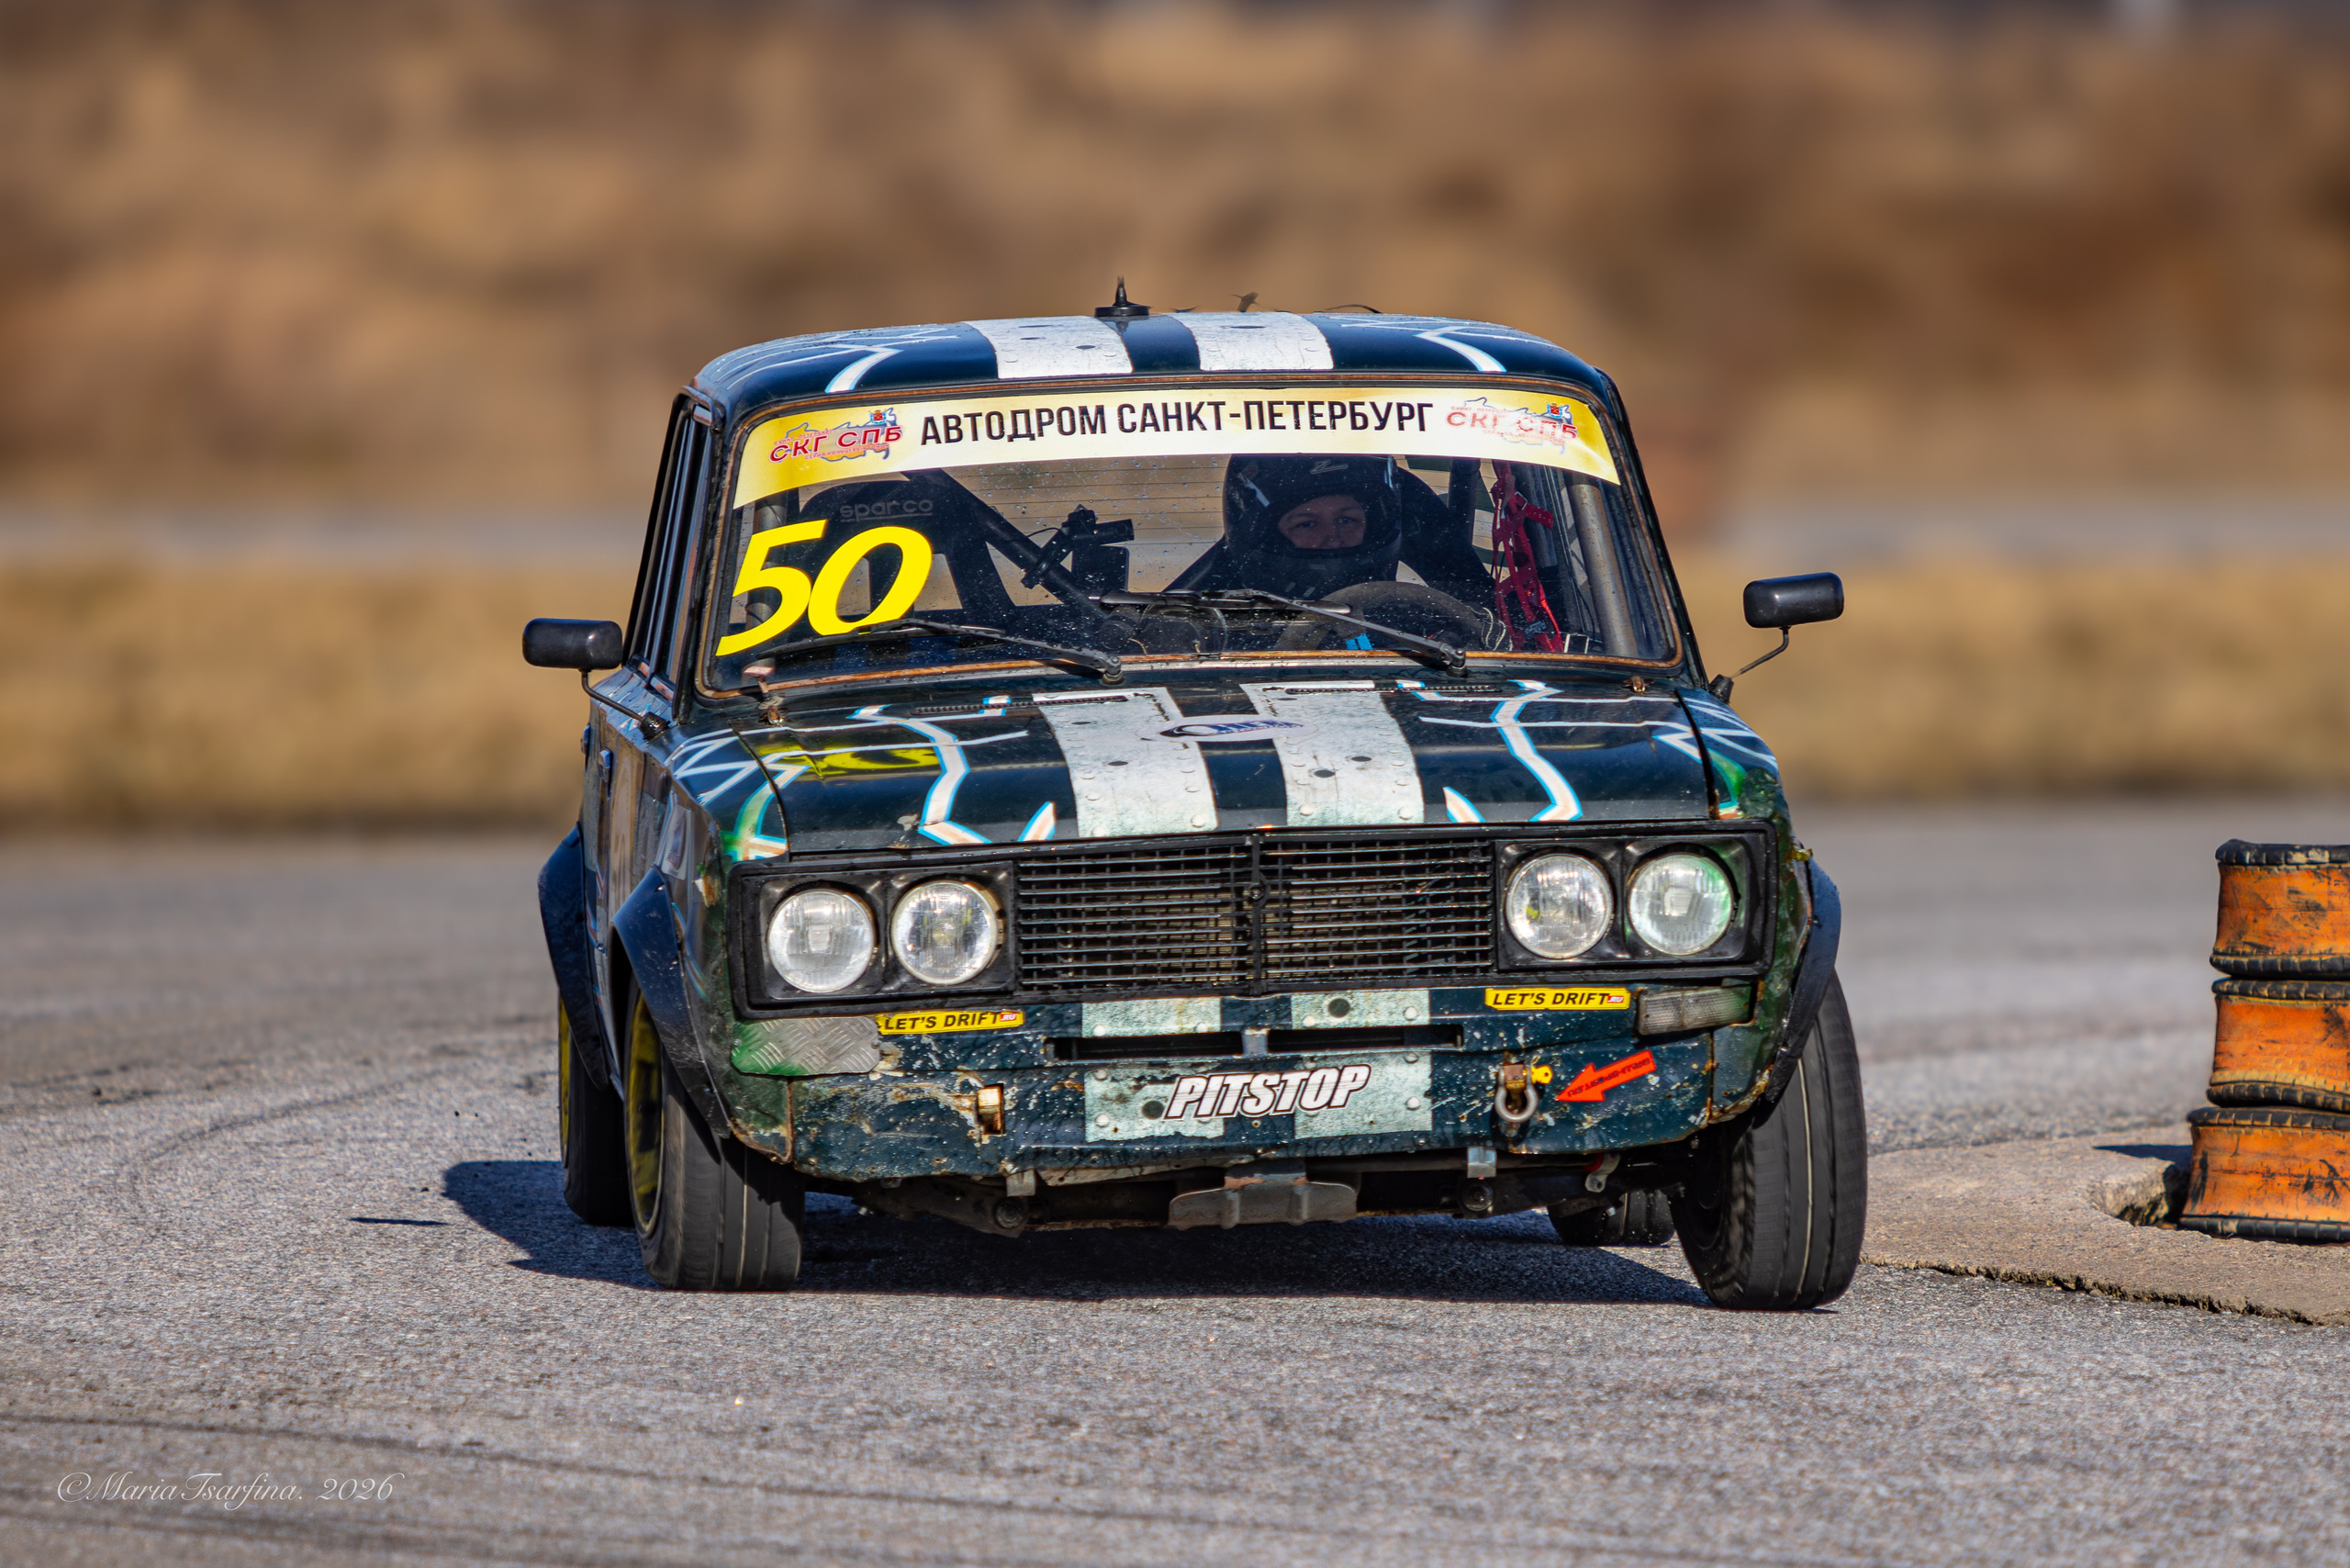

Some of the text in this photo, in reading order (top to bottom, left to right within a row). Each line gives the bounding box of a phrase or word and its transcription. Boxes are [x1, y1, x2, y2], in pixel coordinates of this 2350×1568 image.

[921, 400, 1434, 445] АВТОДРОМ САНКТ-ПЕТЕРБУРГ
[1447, 411, 1505, 428] СКГ
[1516, 417, 1578, 440] СПБ
[769, 426, 902, 462] СКГ СПБ
[839, 498, 934, 521] sparco
[716, 519, 934, 657] 50
[1493, 992, 1546, 1005] LET'S
[884, 1015, 936, 1030] LET'S
[1162, 1064, 1371, 1121] PITSTOP
